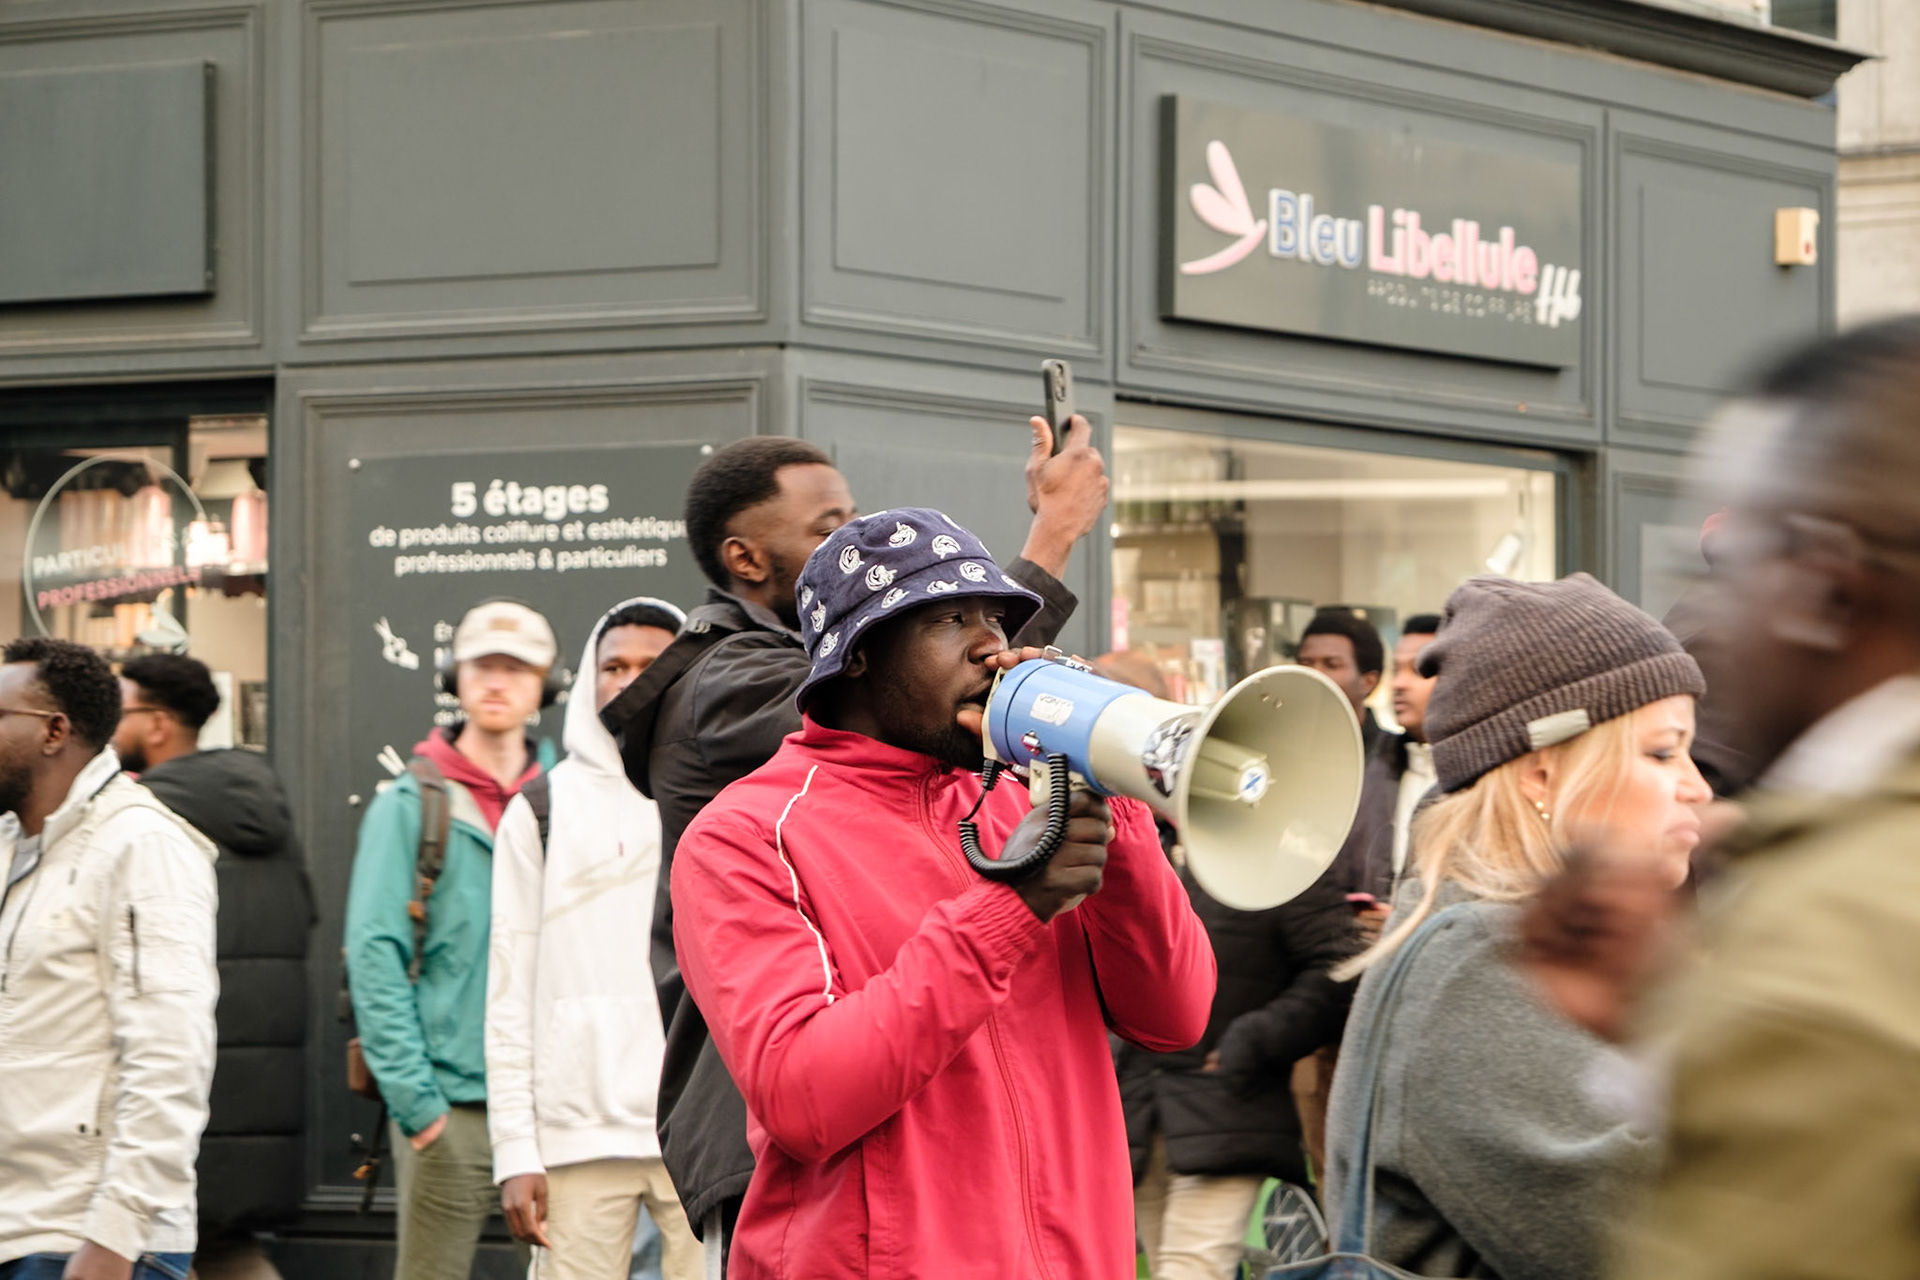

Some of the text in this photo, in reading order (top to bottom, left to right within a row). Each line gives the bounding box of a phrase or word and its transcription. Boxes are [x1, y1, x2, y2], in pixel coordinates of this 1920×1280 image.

[1269, 188, 1538, 294] Bleu Libellule
[451, 479, 609, 521] 5 étages
[369, 526, 397, 547] de
[398, 523, 481, 549] produits
[482, 520, 560, 544] coiffure
[561, 519, 585, 541] et
[394, 545, 668, 577] professionnels & particuliers
[37, 564, 201, 610] PROFESSIONNELS
